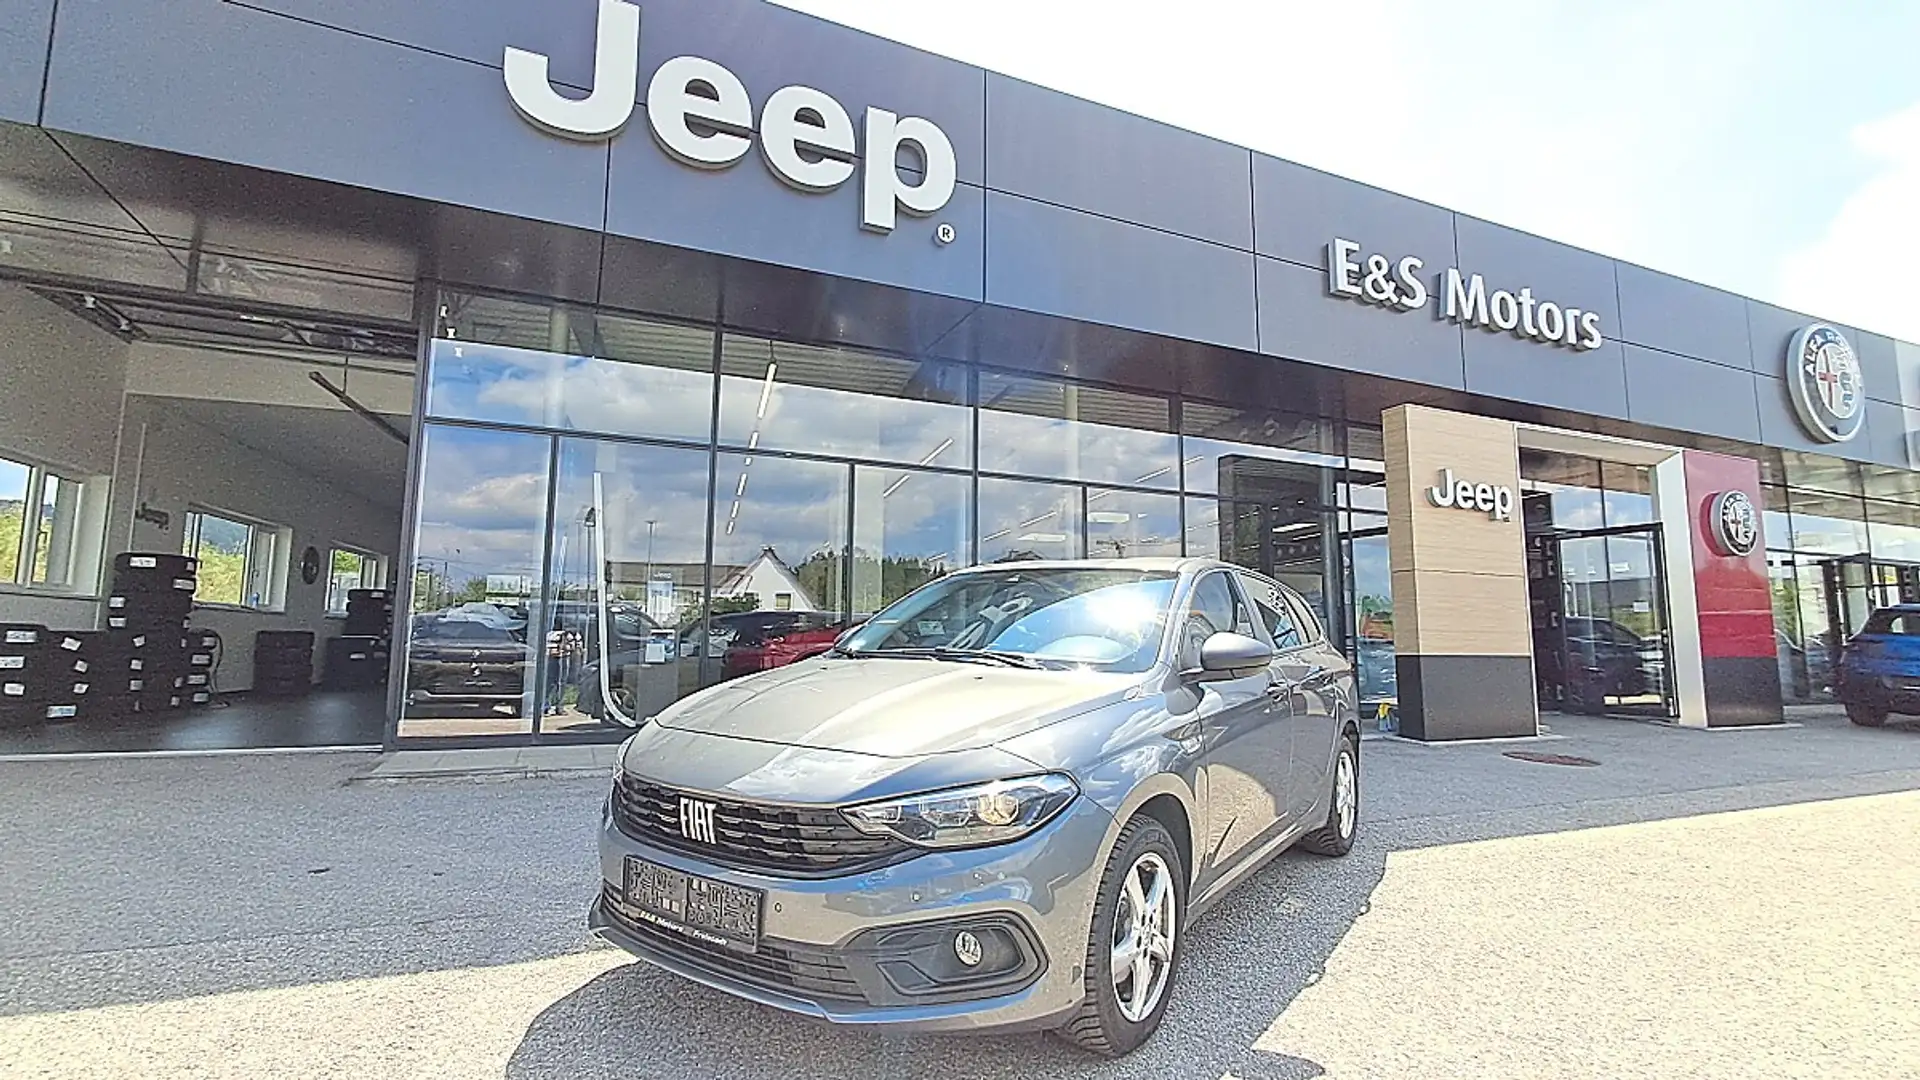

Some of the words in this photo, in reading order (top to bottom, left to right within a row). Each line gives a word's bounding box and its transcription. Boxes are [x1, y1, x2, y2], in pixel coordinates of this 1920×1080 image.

[503, 0, 956, 234] Jeep
[1329, 237, 1427, 311] E&S
[1444, 268, 1603, 350] Motors
[1805, 334, 1823, 377] ALFA
[1427, 468, 1513, 520] Jeep
[679, 797, 717, 845] FIAT
